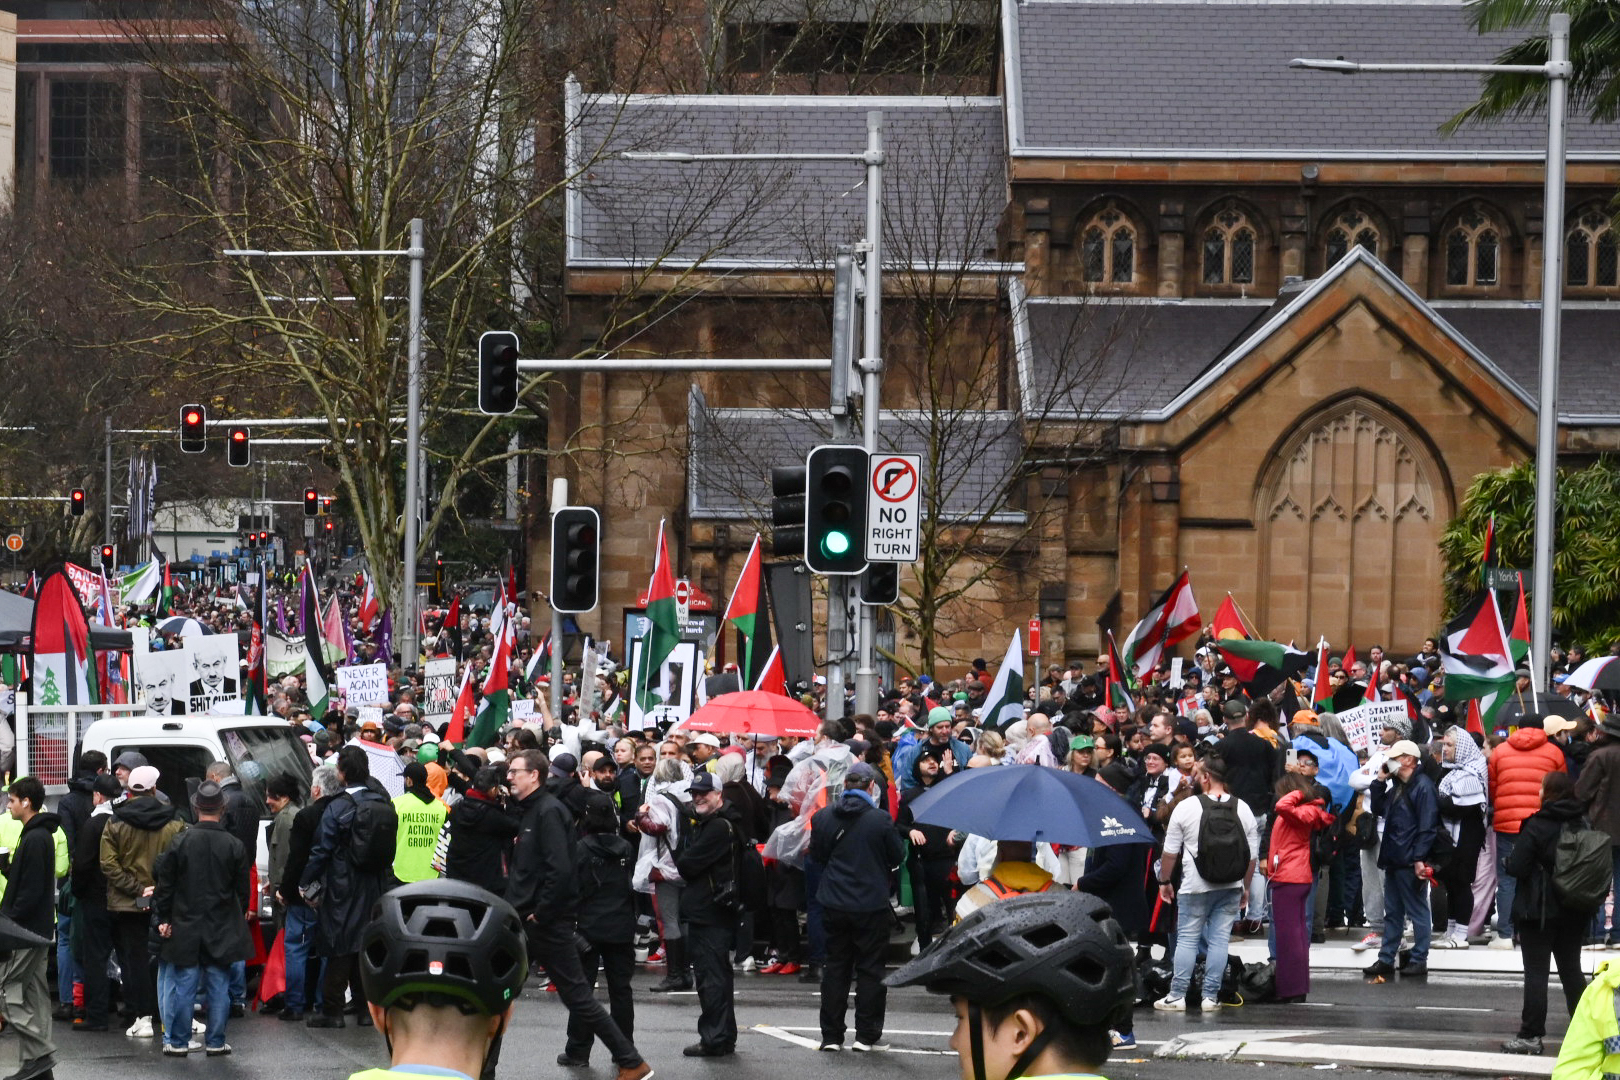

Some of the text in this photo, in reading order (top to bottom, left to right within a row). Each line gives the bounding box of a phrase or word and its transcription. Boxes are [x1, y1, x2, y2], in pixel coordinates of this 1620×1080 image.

[879, 507, 907, 523] NO
[872, 527, 913, 539] RIGHT
[11, 538, 19, 548] T
[873, 543, 911, 555] TURN
[68, 566, 125, 586] SANCON
[1498, 570, 1514, 582] York
[678, 607, 686, 615] NO
[685, 624, 703, 634] hurch
[346, 690, 386, 703] REALLY?
[514, 701, 532, 712] NOT
[1368, 704, 1405, 716] STARVING
[1347, 727, 1365, 738] PART
[402, 812, 440, 824] PALESTINE
[407, 824, 435, 836] ACTION
[407, 837, 434, 848] GROUP
